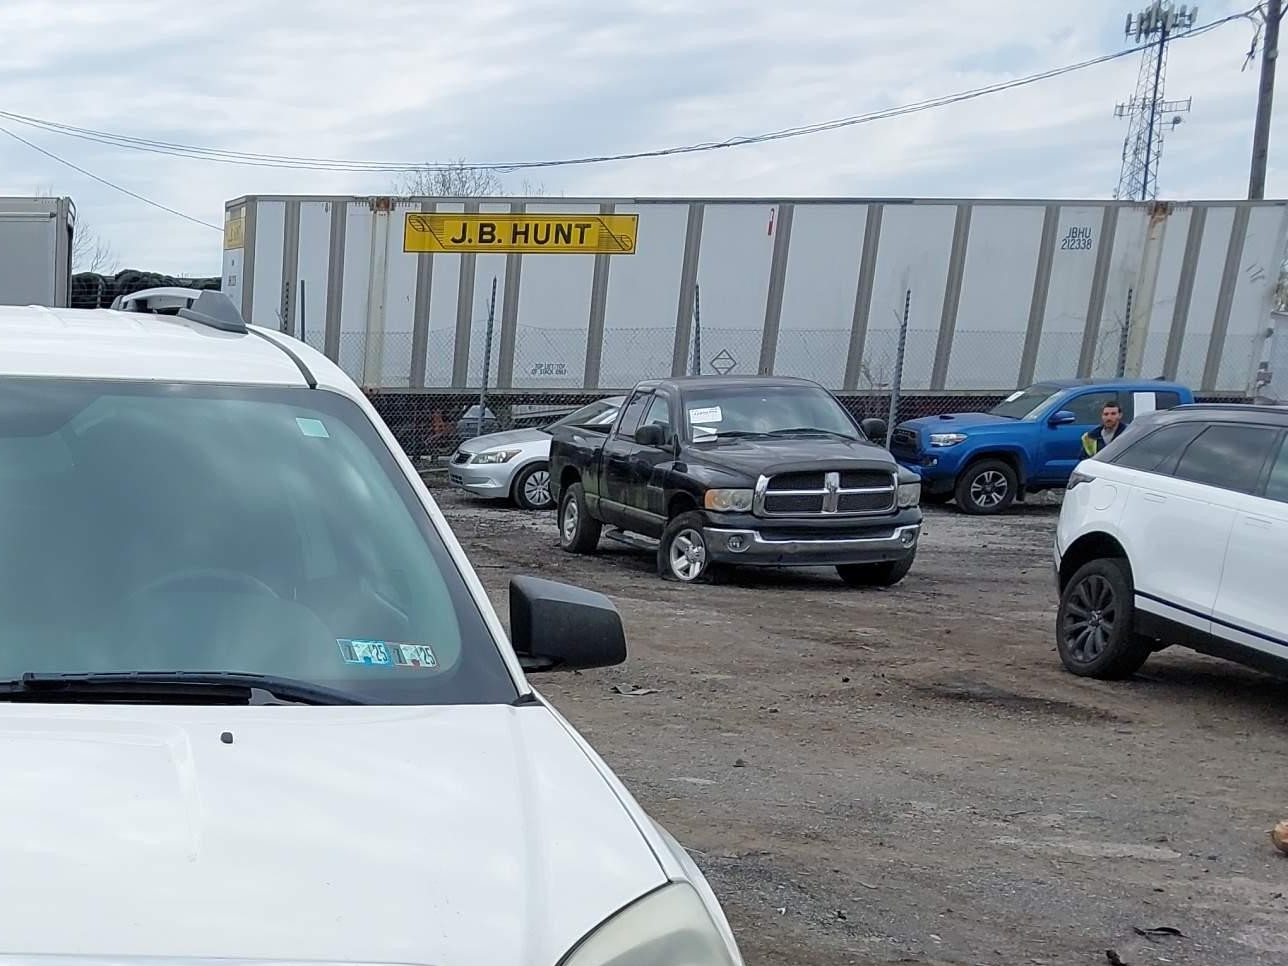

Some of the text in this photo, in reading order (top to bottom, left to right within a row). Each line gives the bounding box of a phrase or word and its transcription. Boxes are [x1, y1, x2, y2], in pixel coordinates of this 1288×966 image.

[511, 223, 591, 245] HUNT
[1065, 227, 1092, 239] JBHU
[1061, 239, 1092, 250] 212338
